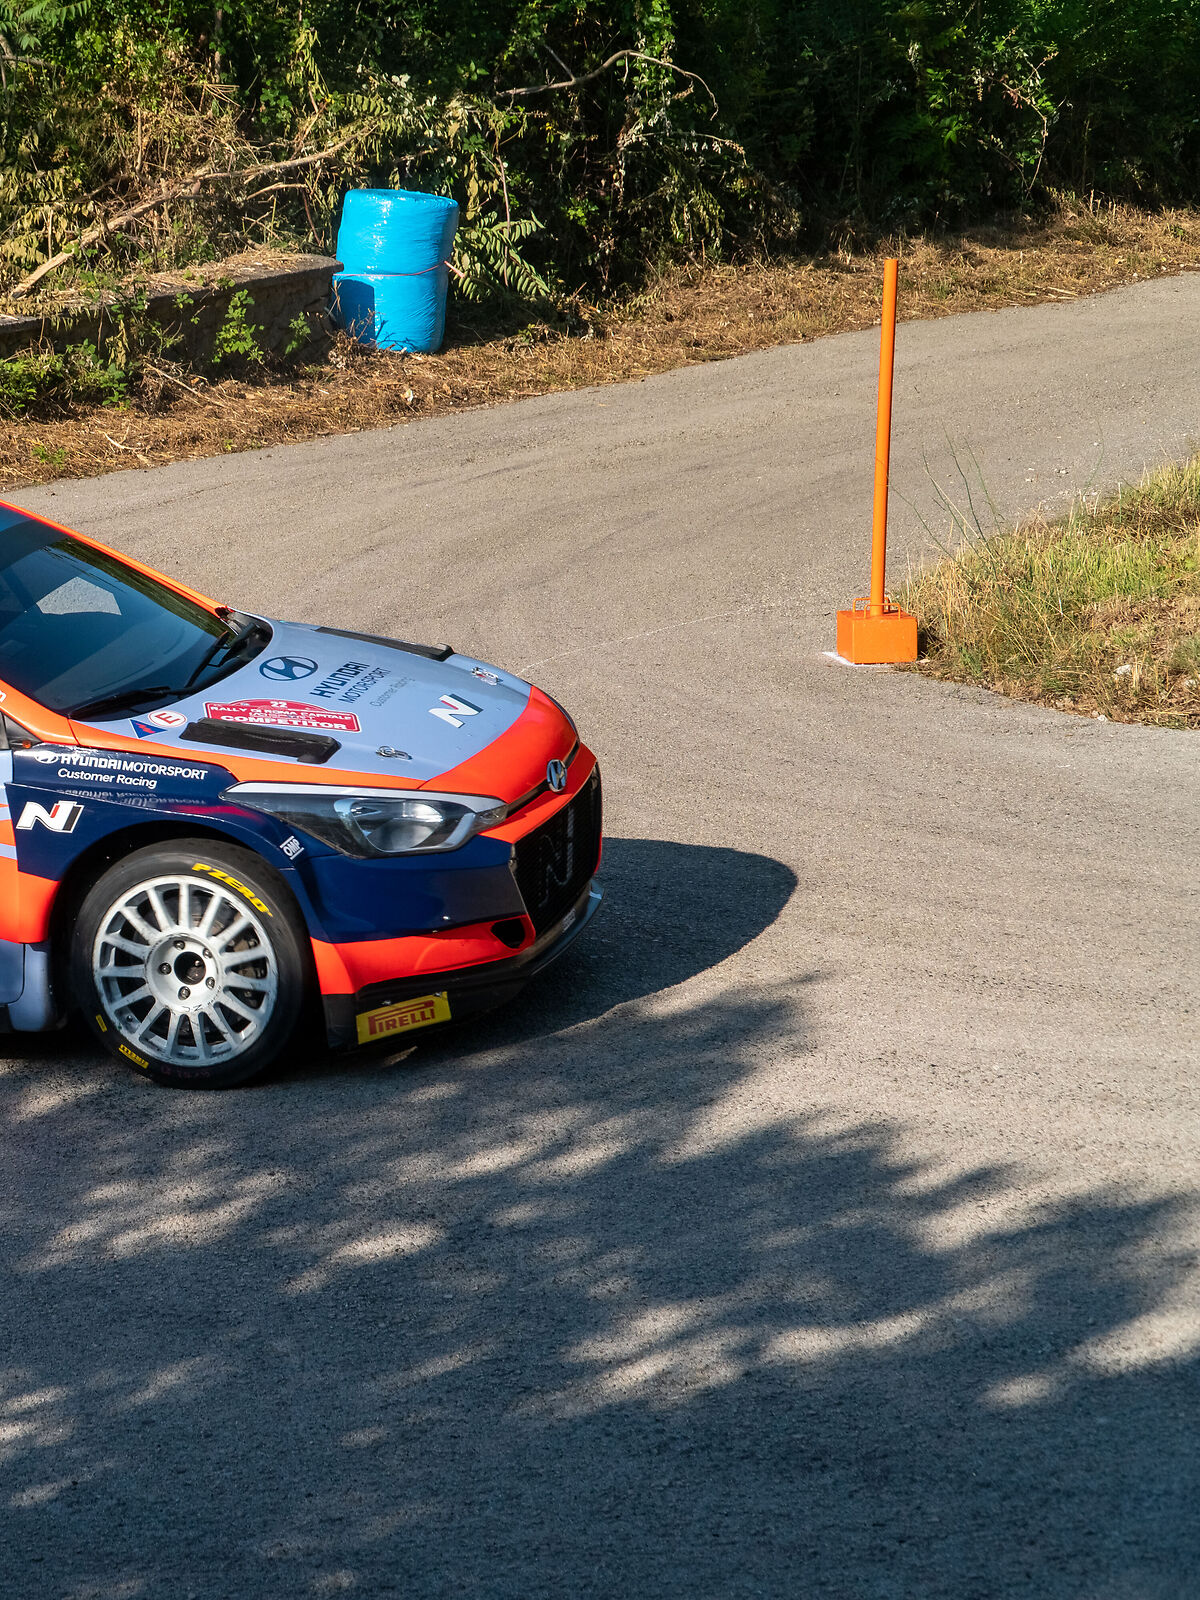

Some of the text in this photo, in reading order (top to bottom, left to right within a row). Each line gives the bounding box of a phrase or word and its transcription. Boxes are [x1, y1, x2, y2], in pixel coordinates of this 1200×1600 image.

[309, 661, 370, 698] HYUNDAI
[338, 667, 391, 704] MOTORSPORT
[154, 712, 181, 725] E
[220, 715, 347, 730] COMPETITOR
[299, 711, 352, 720] CAPITALE
[60, 753, 208, 780] HYUNDAI MOTORSPORT
[57, 767, 158, 790] Customer Racing
[282, 837, 301, 858] OMP
[367, 999, 436, 1035] PIRELLI
